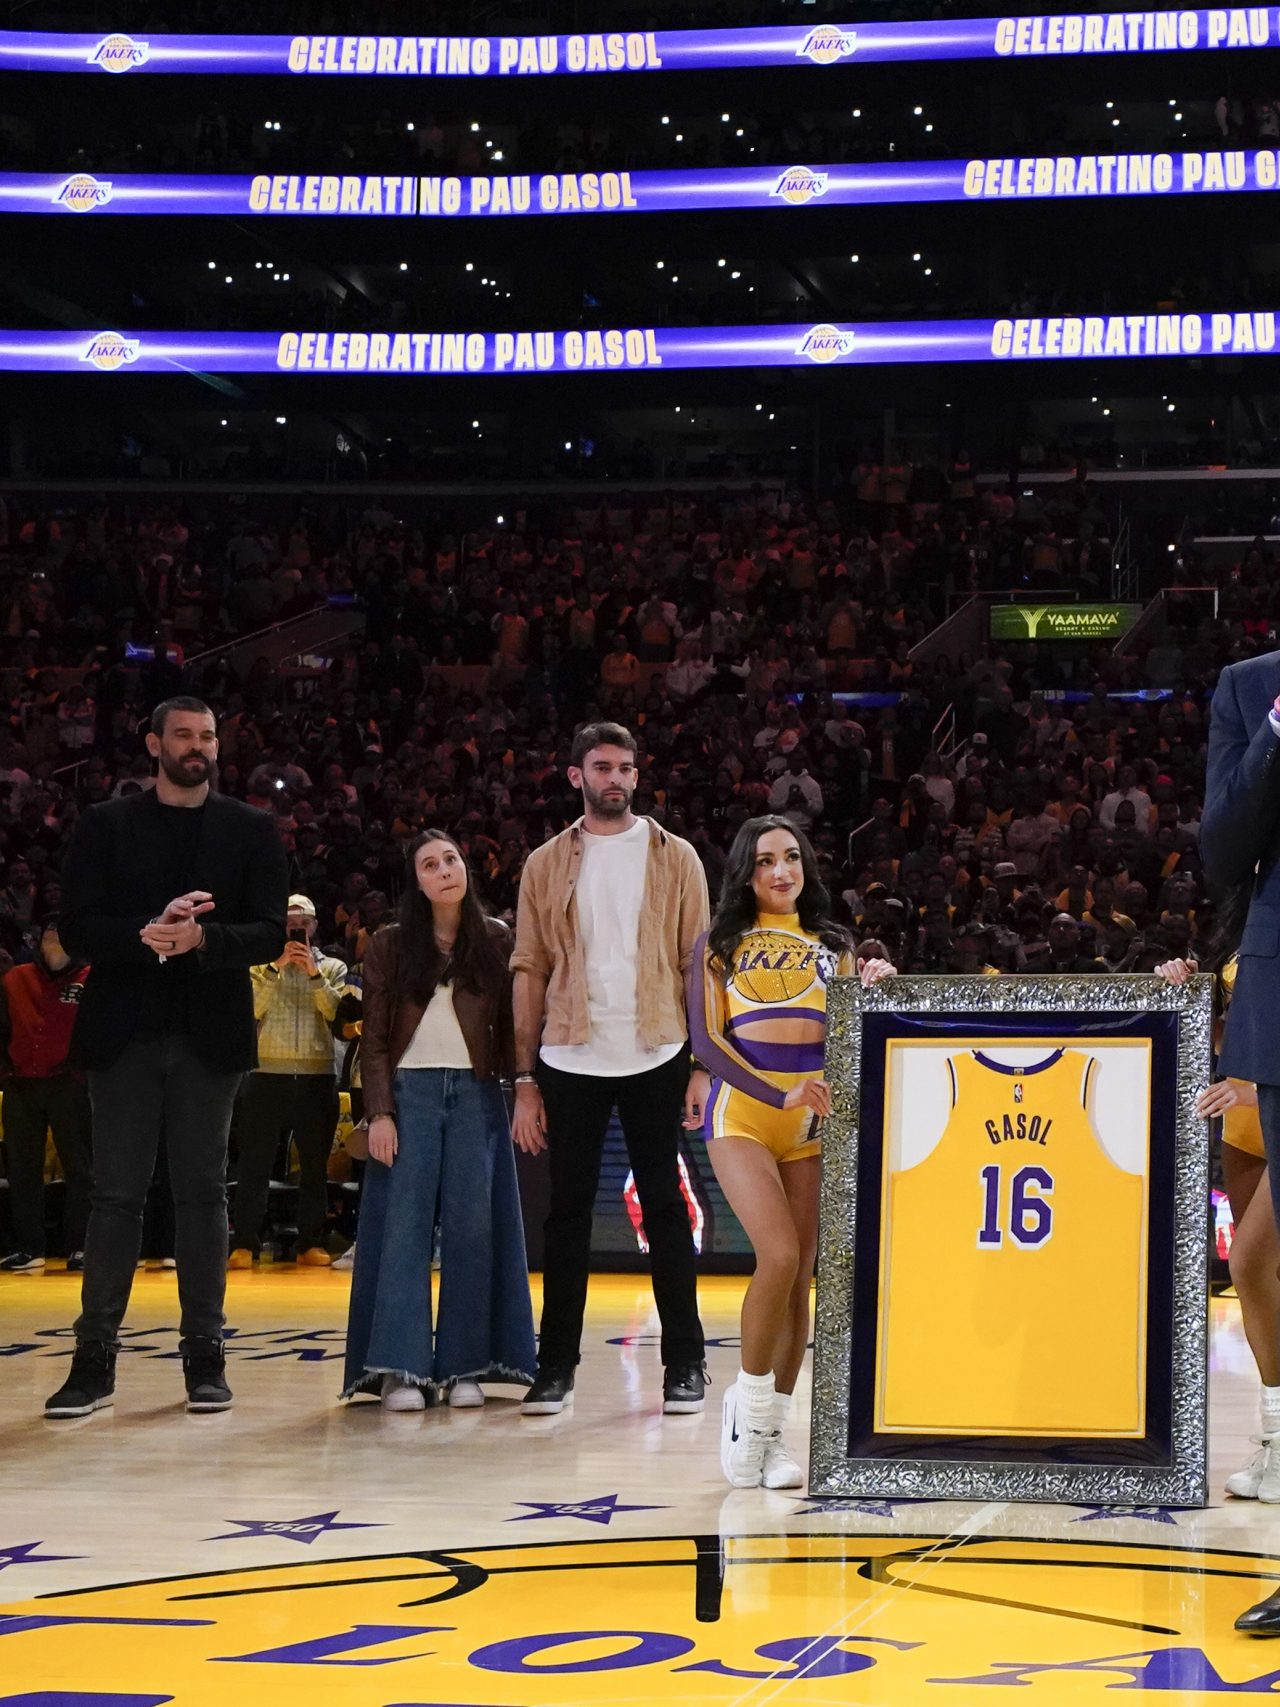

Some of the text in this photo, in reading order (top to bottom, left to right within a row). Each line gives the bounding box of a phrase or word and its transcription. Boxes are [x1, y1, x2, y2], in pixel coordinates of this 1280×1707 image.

[994, 11, 1198, 54] CELEBRATING
[1209, 9, 1269, 46] PAU
[288, 33, 662, 74] CELEBRATING PAU GASOL
[249, 172, 637, 213] CELEBRATING PAU GASOL
[964, 153, 1172, 197] CELEBRATING
[1183, 151, 1245, 190] PAU
[277, 329, 662, 371] CELEBRATING PAU GASOL
[991, 314, 1201, 357] CELEBRATING
[1212, 312, 1275, 351] PAU
[736, 950, 838, 984] AKERS
[985, 1113, 1053, 1146] GASOL
[977, 1165, 1054, 1249] 16
[207, 1624, 927, 1679] LOS
